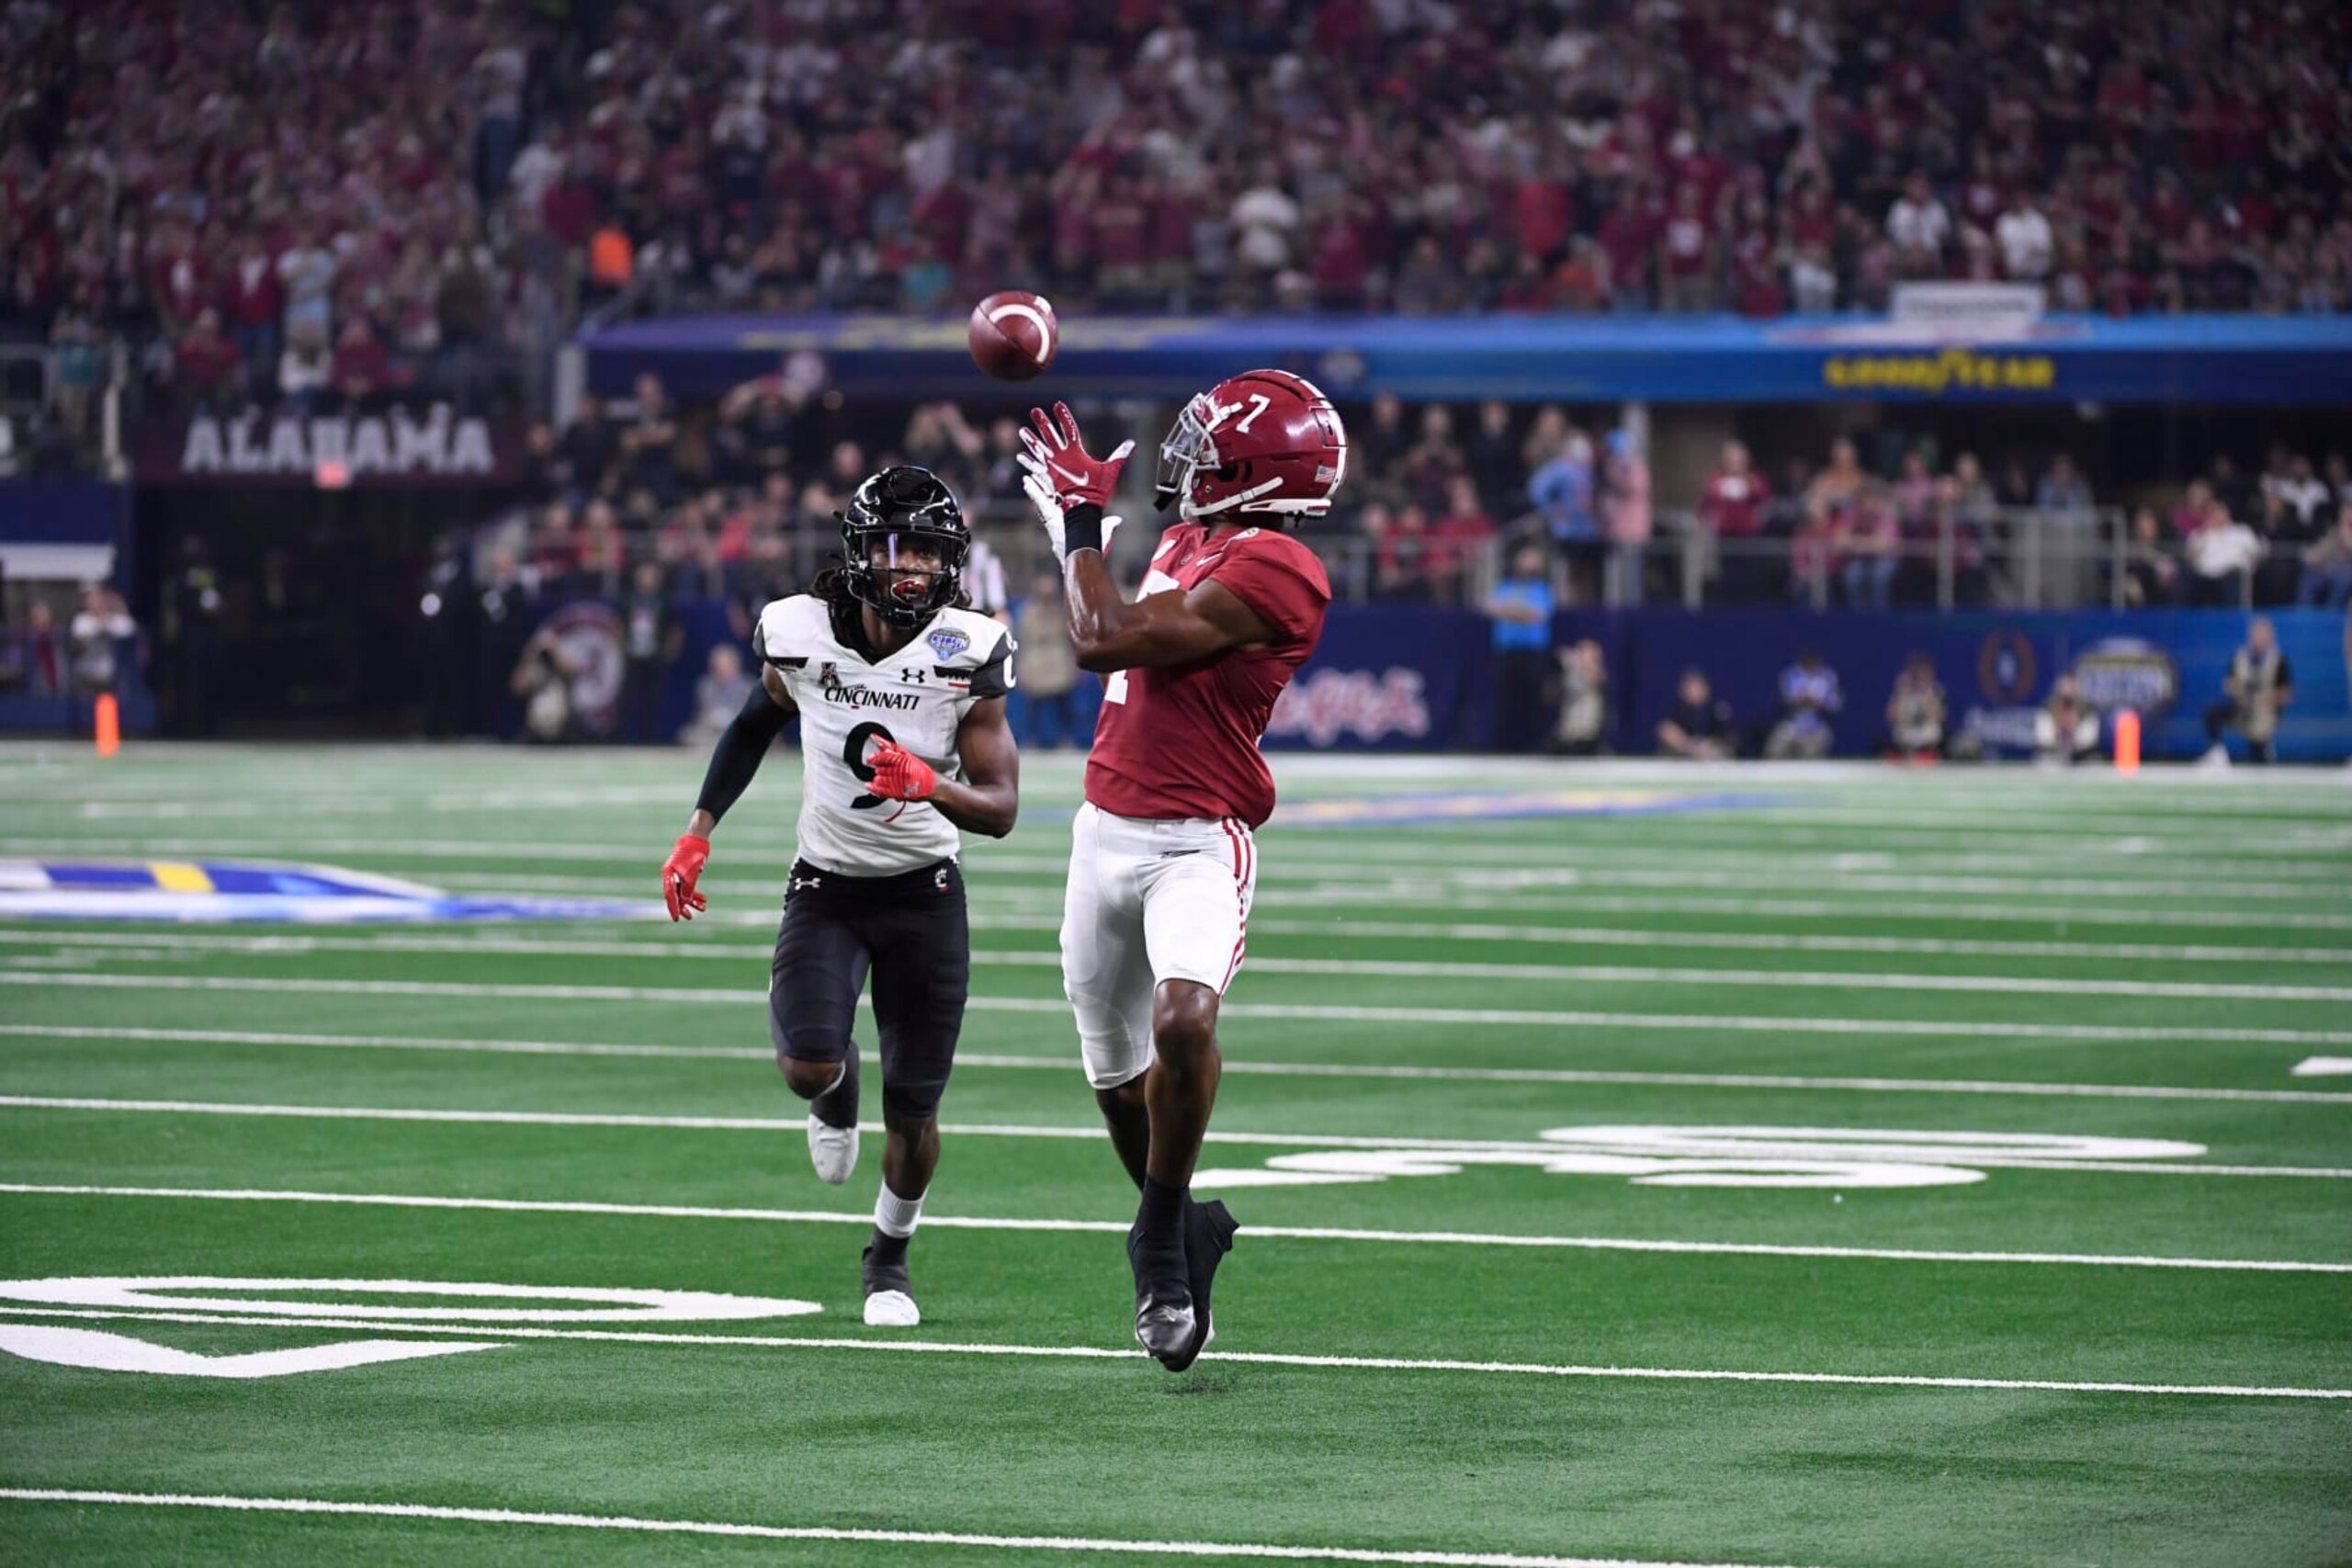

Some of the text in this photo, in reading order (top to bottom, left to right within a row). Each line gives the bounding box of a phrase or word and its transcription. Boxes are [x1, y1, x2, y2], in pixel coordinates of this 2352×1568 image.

[1236, 393, 1271, 434] 7
[182, 412, 492, 473] ALABAMA
[824, 684, 921, 710] CINCINNATI
[843, 721, 897, 809] 9
